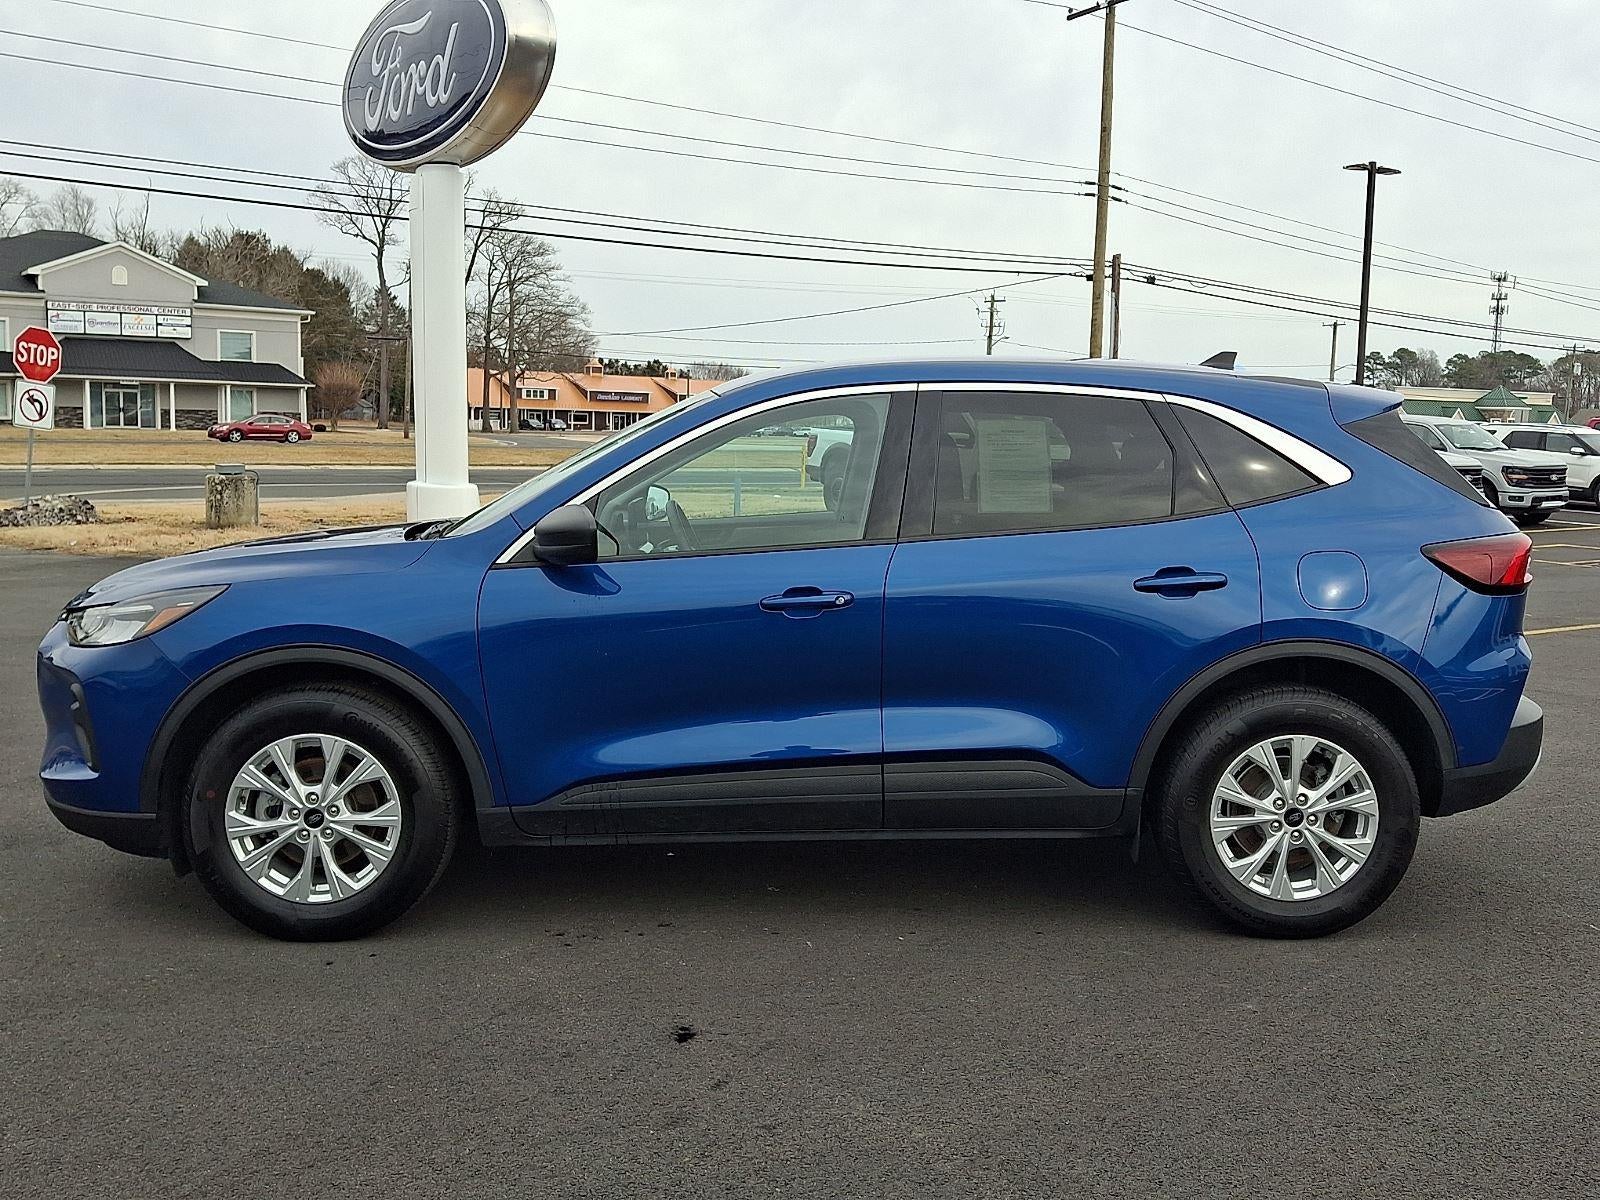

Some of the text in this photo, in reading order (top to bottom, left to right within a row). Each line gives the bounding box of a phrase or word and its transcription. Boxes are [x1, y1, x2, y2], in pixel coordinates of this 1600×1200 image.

[364, 10, 459, 132] Ford
[51, 302, 93, 310] EAST-SIDE
[96, 304, 155, 313] PROFESSIONAL
[17, 341, 58, 367] STOP
